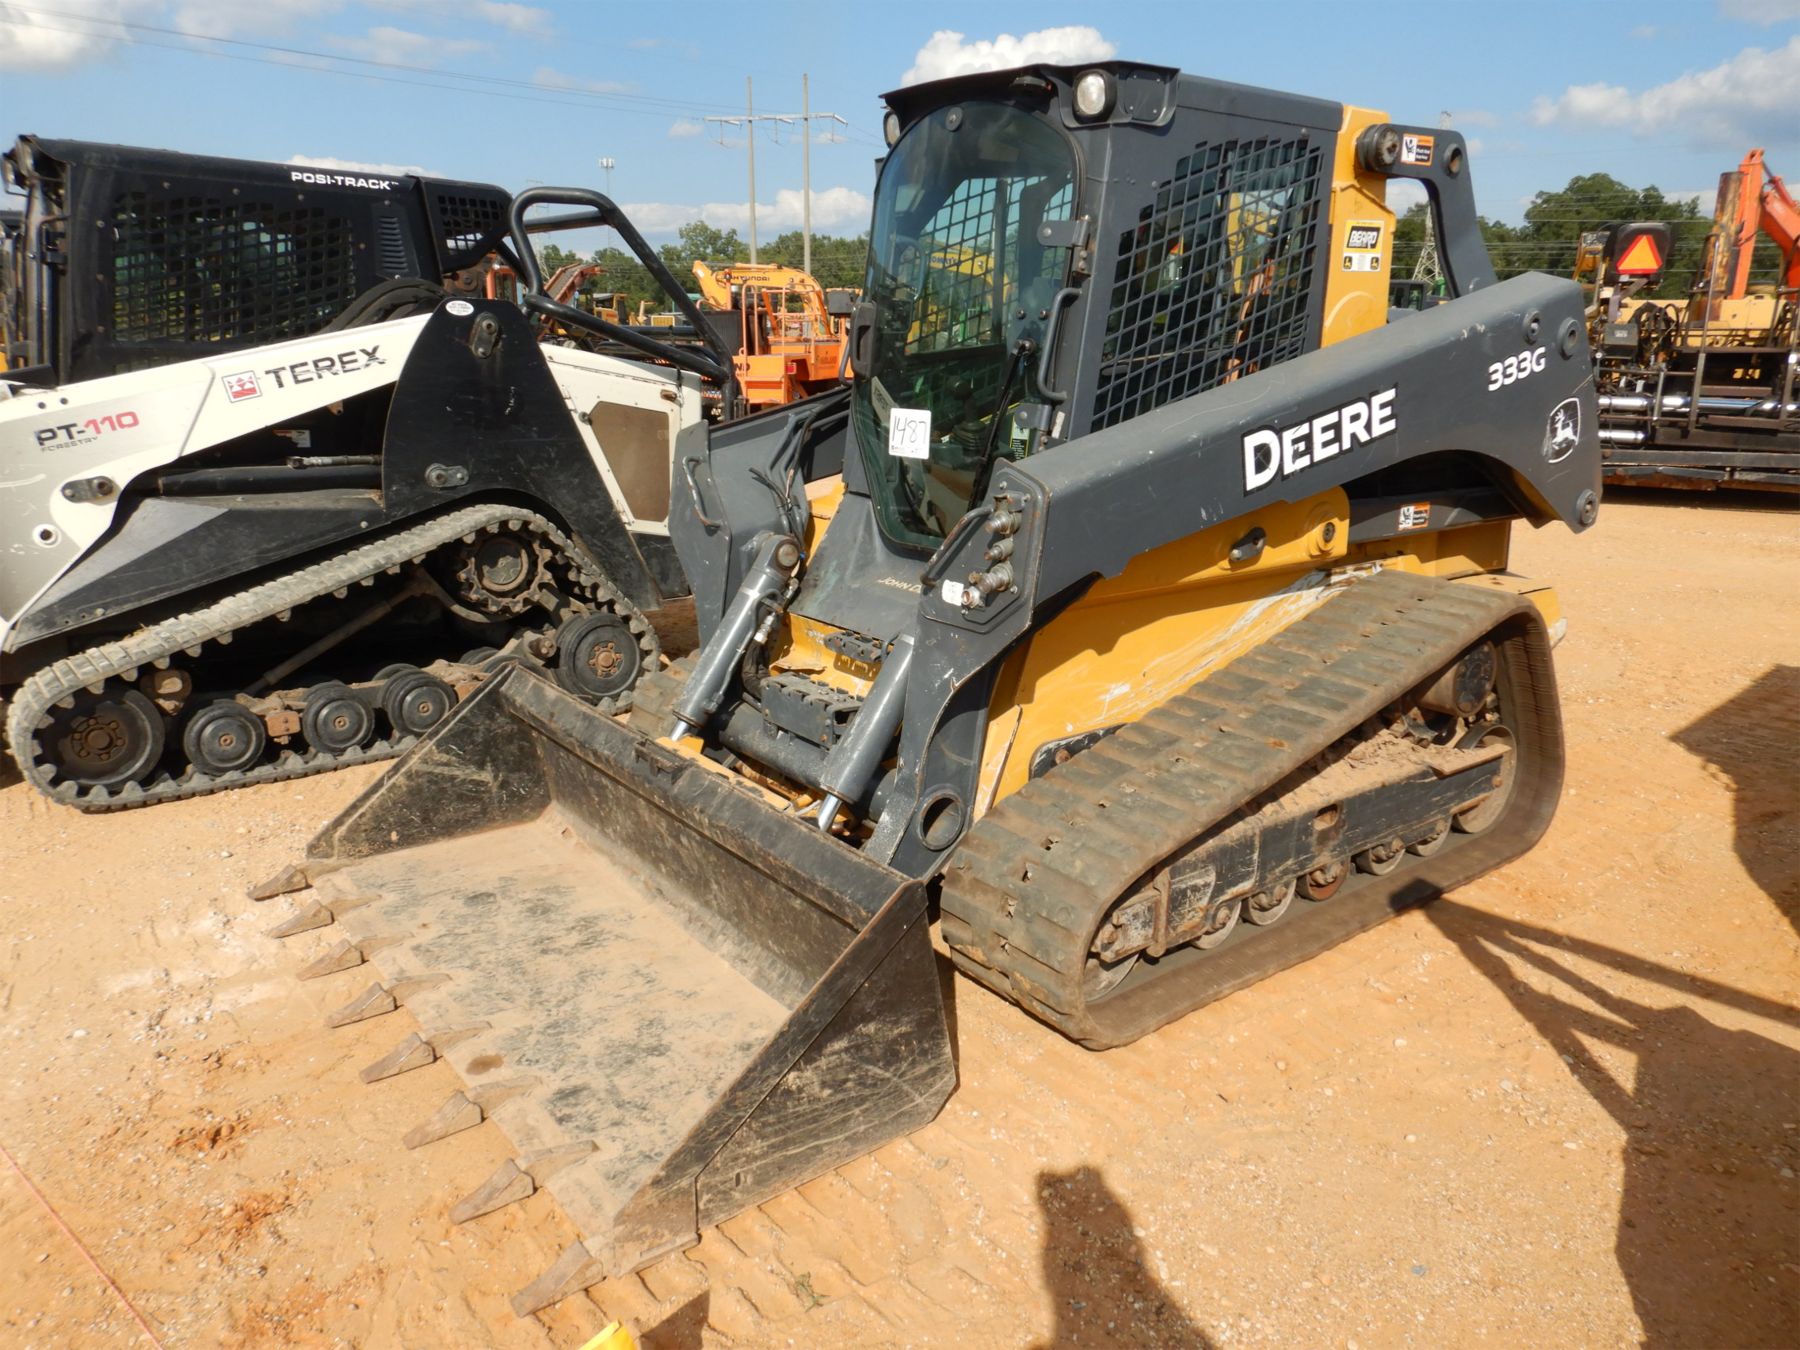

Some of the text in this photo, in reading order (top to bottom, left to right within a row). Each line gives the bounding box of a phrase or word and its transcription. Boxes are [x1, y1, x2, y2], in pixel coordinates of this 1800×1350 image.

[265, 345, 387, 388] TEREX
[1488, 347, 1546, 391] 333G
[35, 411, 140, 446] PT-110
[41, 436, 98, 452] FORESTRY
[892, 415, 927, 445] 1487
[1243, 388, 1397, 491] DEERE
[878, 576, 911, 589] JOHN
